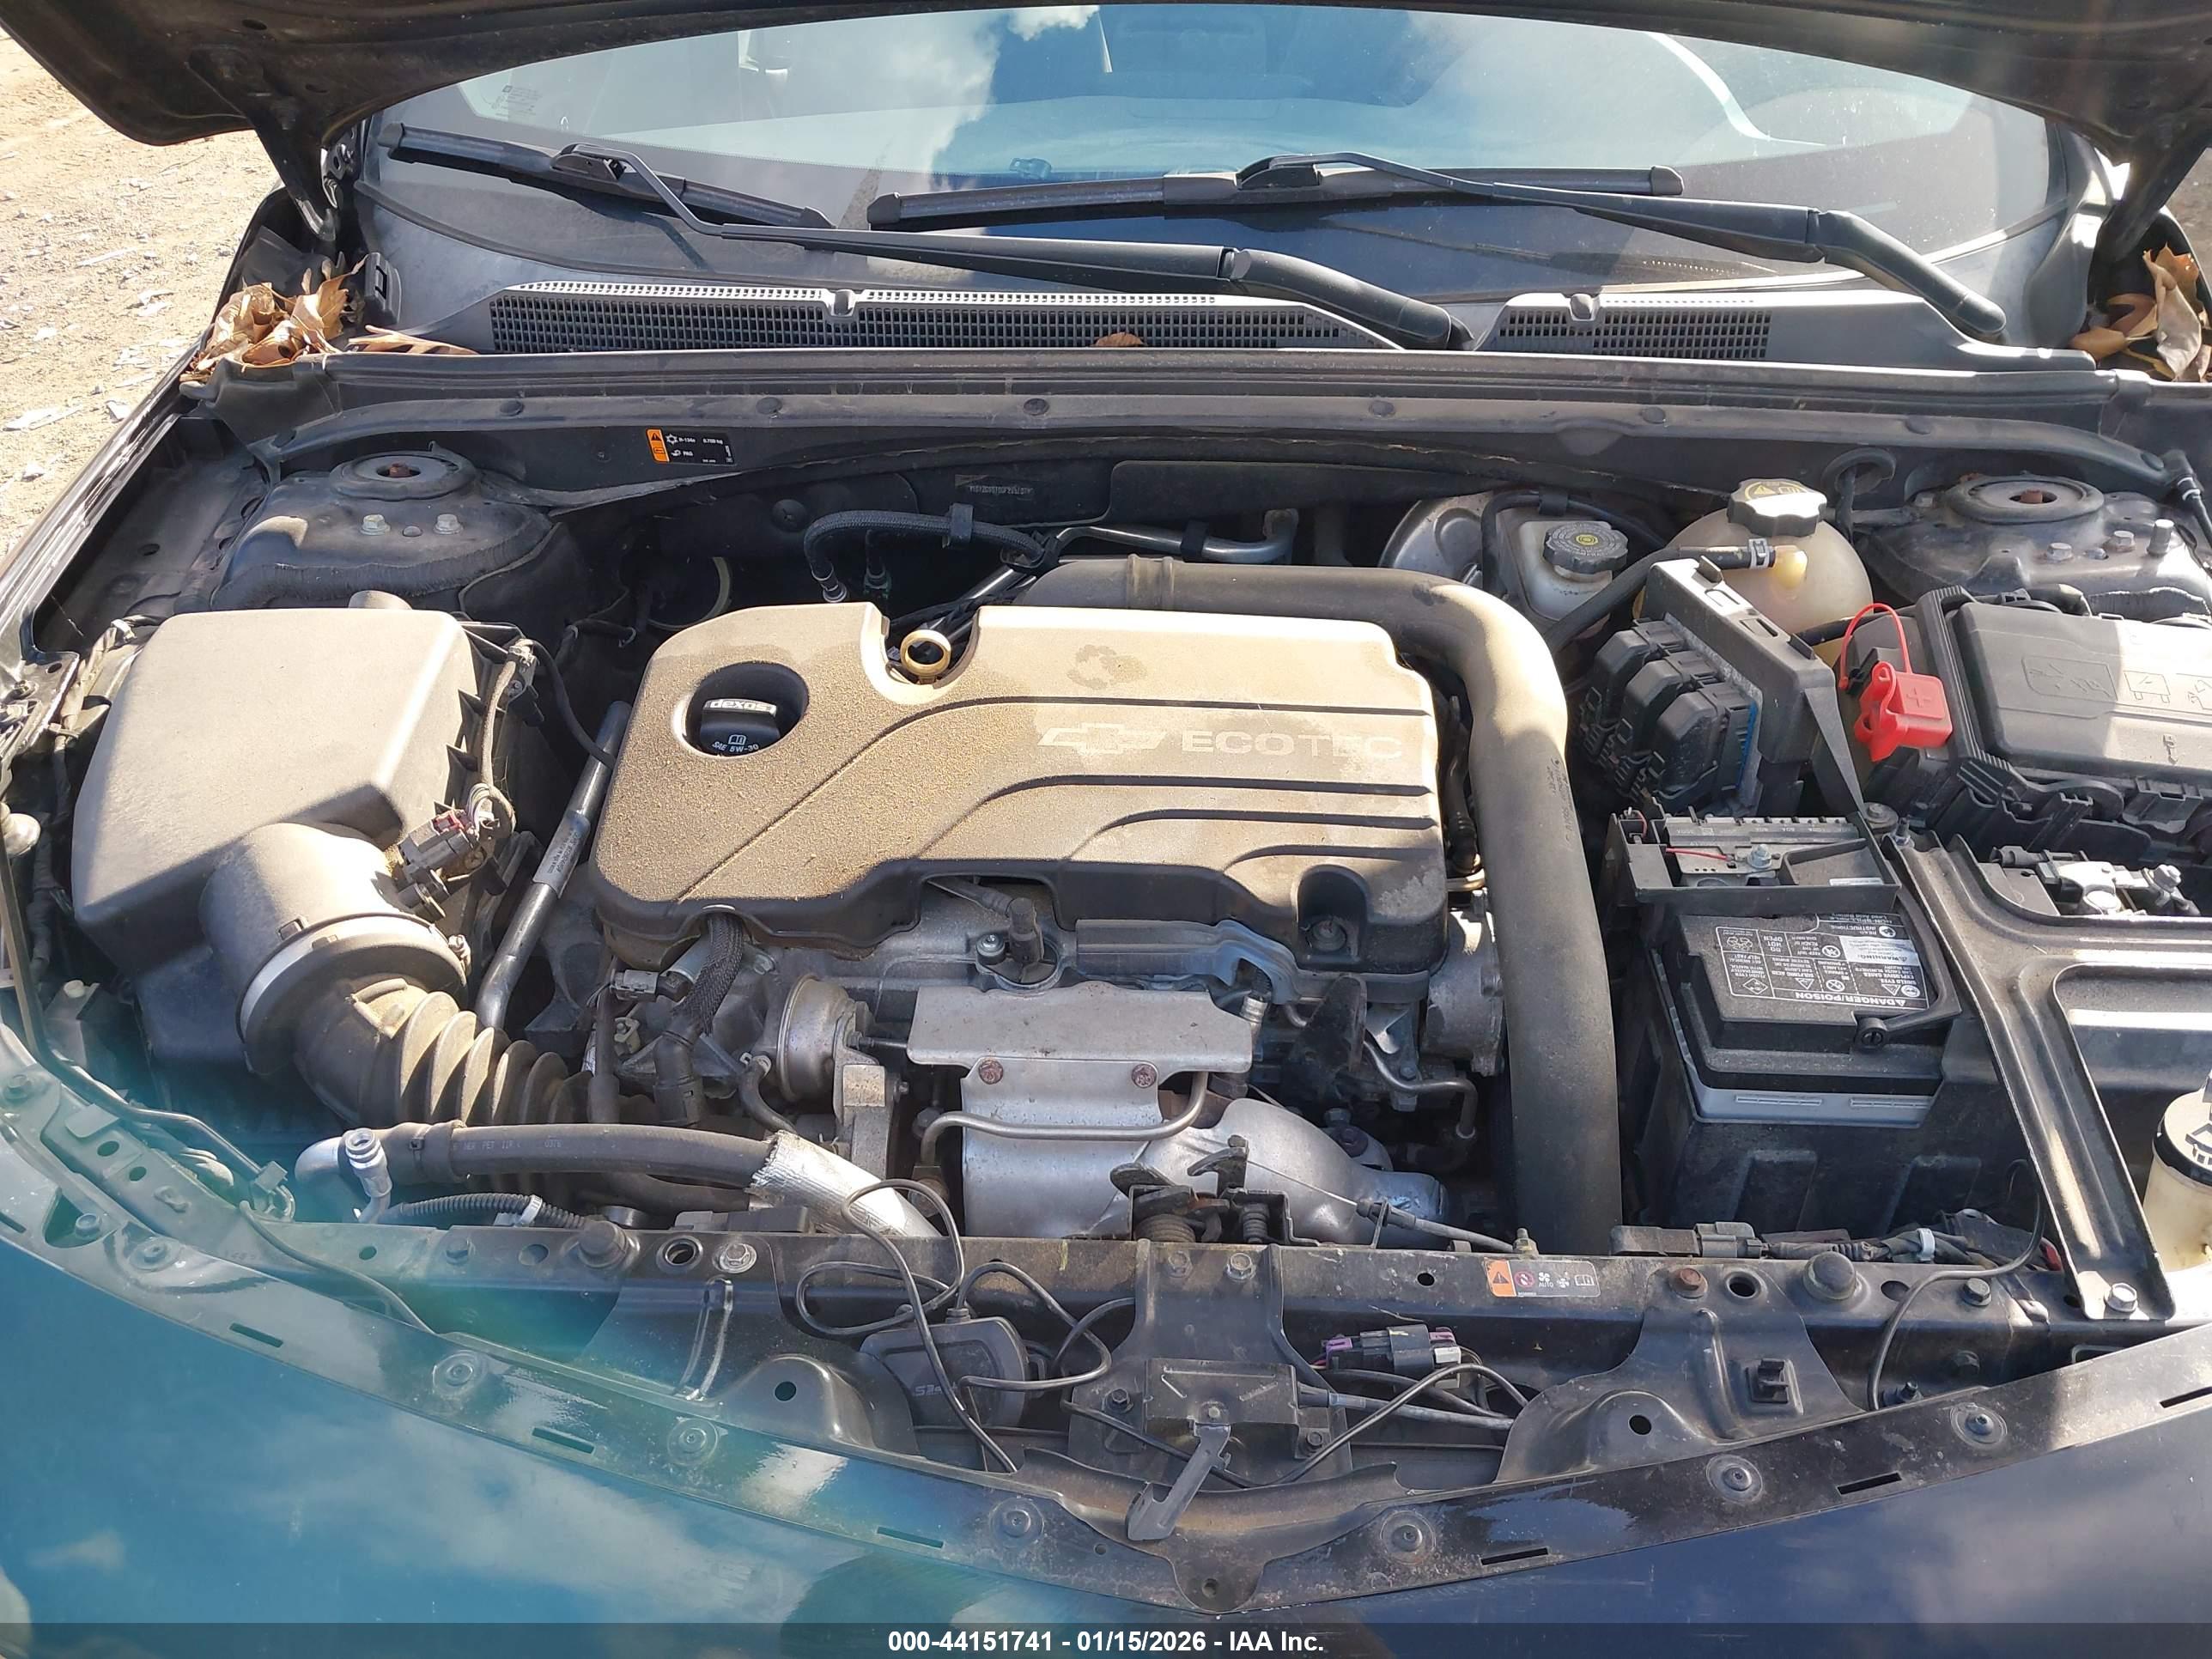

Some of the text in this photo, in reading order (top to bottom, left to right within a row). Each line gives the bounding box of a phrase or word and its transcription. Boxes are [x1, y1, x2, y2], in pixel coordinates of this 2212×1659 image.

[710, 699, 766, 712] dexos
[712, 741, 759, 753] SAE 5W-30
[1182, 730, 1403, 759] ECOTEC
[1796, 992, 1896, 1006] DANGER/POISON
